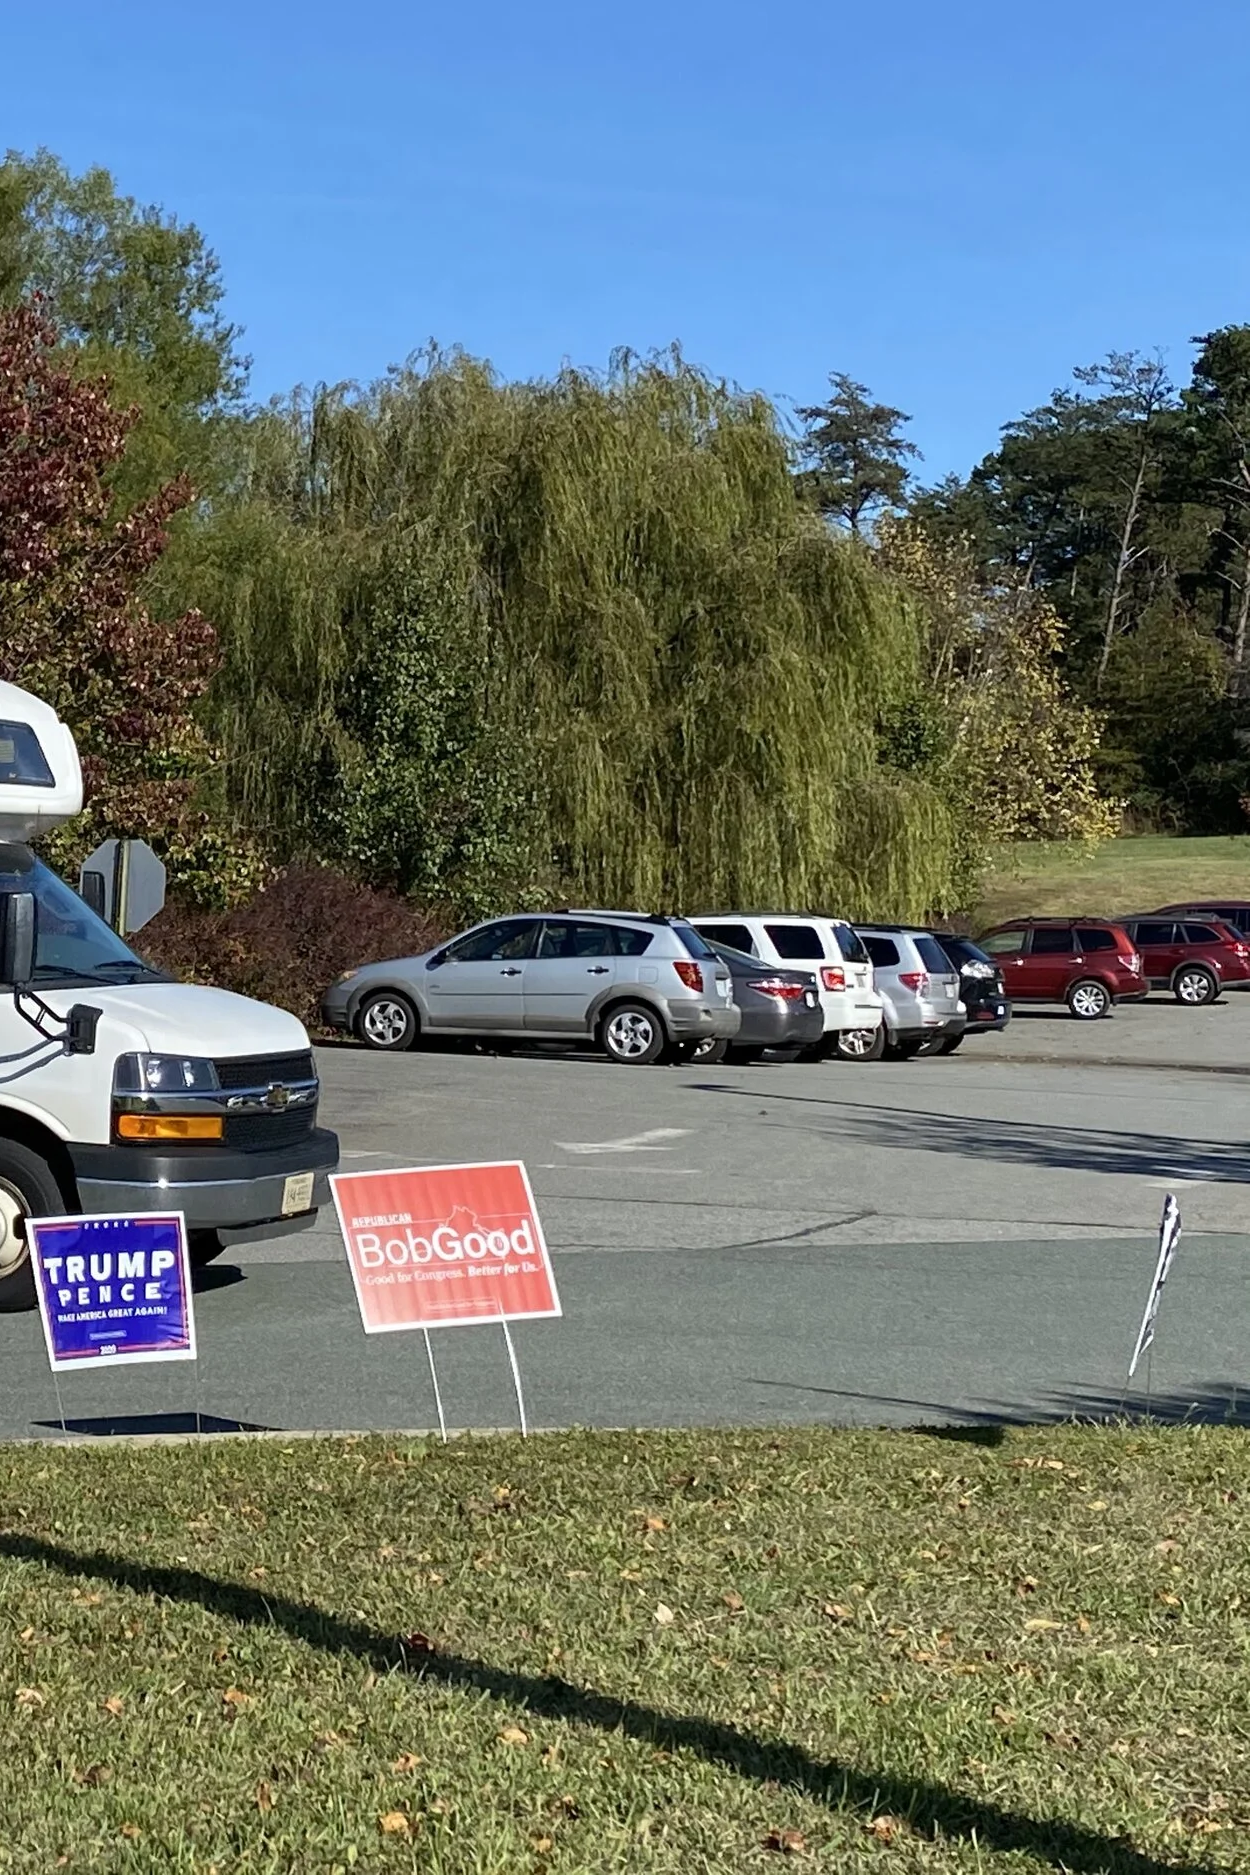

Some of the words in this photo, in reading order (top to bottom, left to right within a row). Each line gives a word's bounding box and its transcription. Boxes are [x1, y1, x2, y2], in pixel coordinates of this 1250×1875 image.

[351, 1213, 412, 1228] REPUBLICAN
[43, 1250, 175, 1285] TRUMP
[365, 1273, 395, 1286] Good
[397, 1270, 413, 1283] for
[414, 1268, 466, 1285] Congress.
[467, 1263, 502, 1277] Better
[503, 1262, 520, 1277] for
[57, 1282, 162, 1307] PENCE
[76, 1310, 107, 1322] AMERICA
[107, 1307, 134, 1319] GREAT
